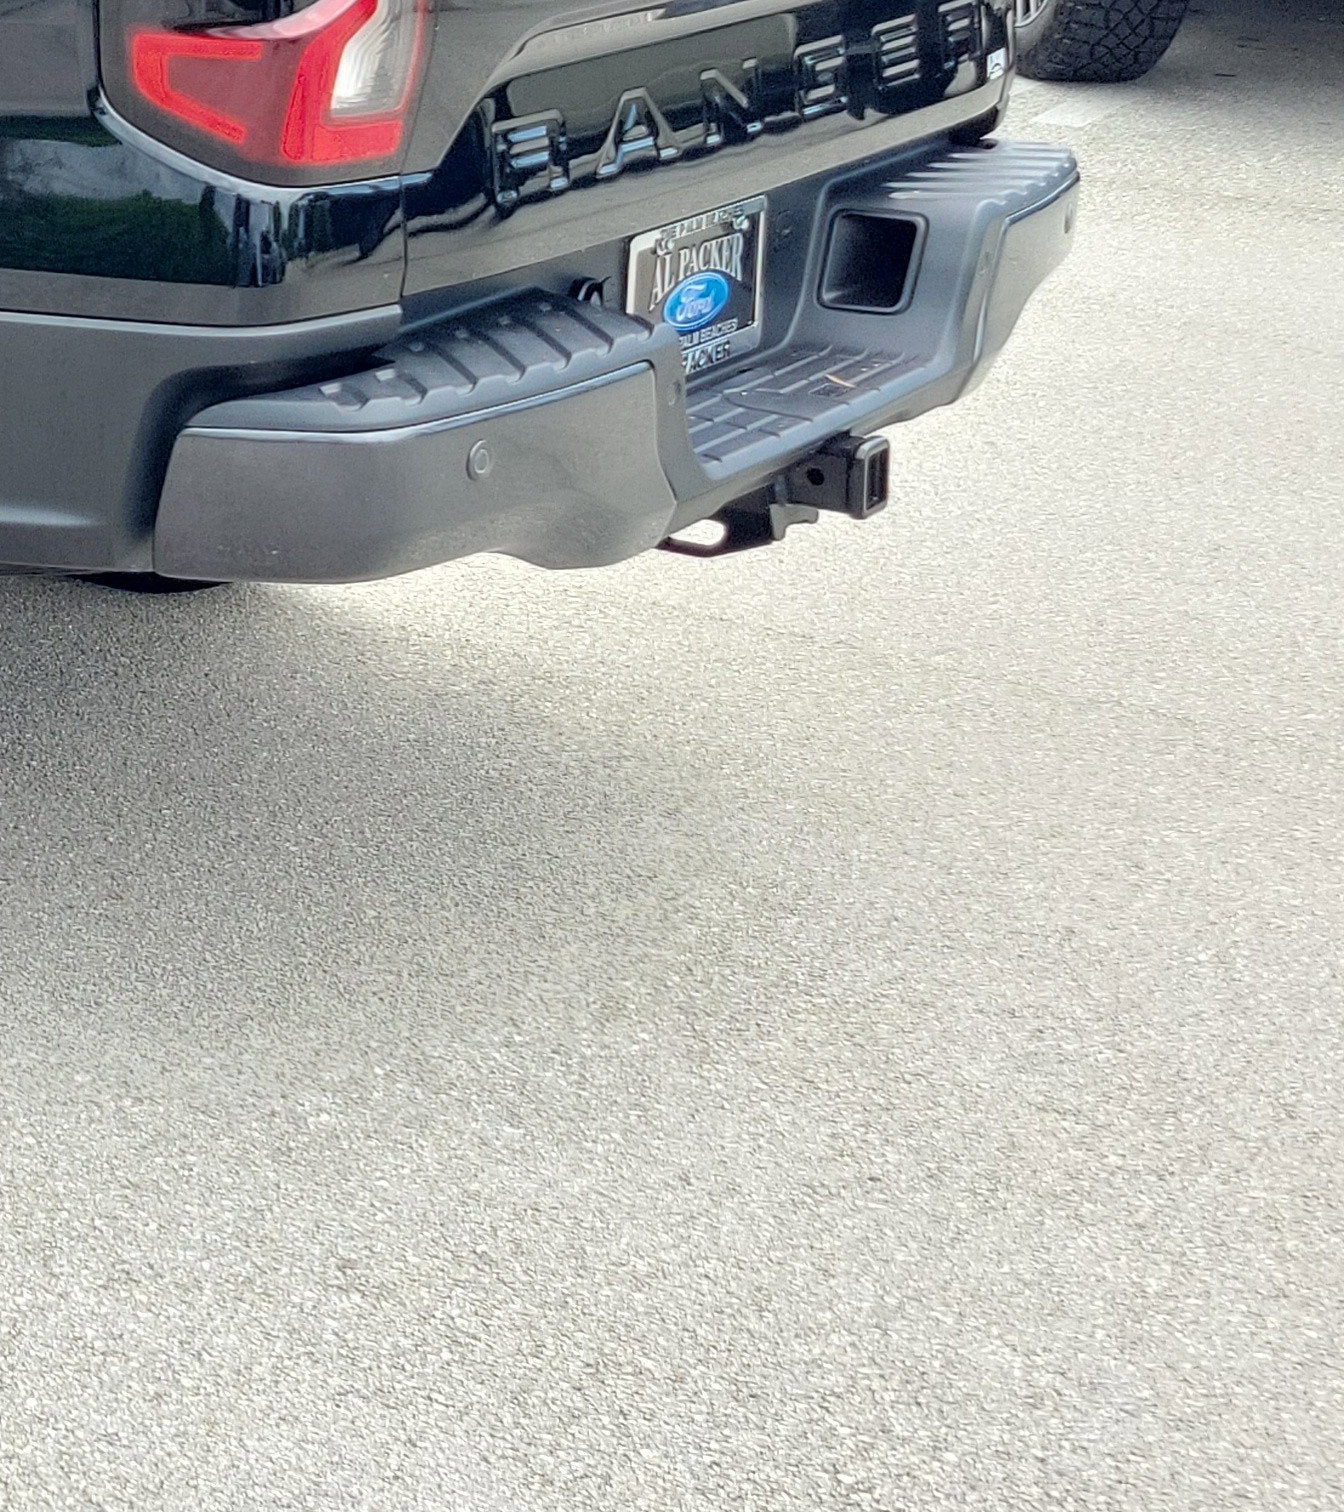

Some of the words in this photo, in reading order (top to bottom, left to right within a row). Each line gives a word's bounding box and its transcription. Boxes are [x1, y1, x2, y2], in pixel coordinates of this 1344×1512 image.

[648, 252, 676, 314] AL
[678, 232, 744, 282] PACKER
[674, 283, 718, 322] Ford
